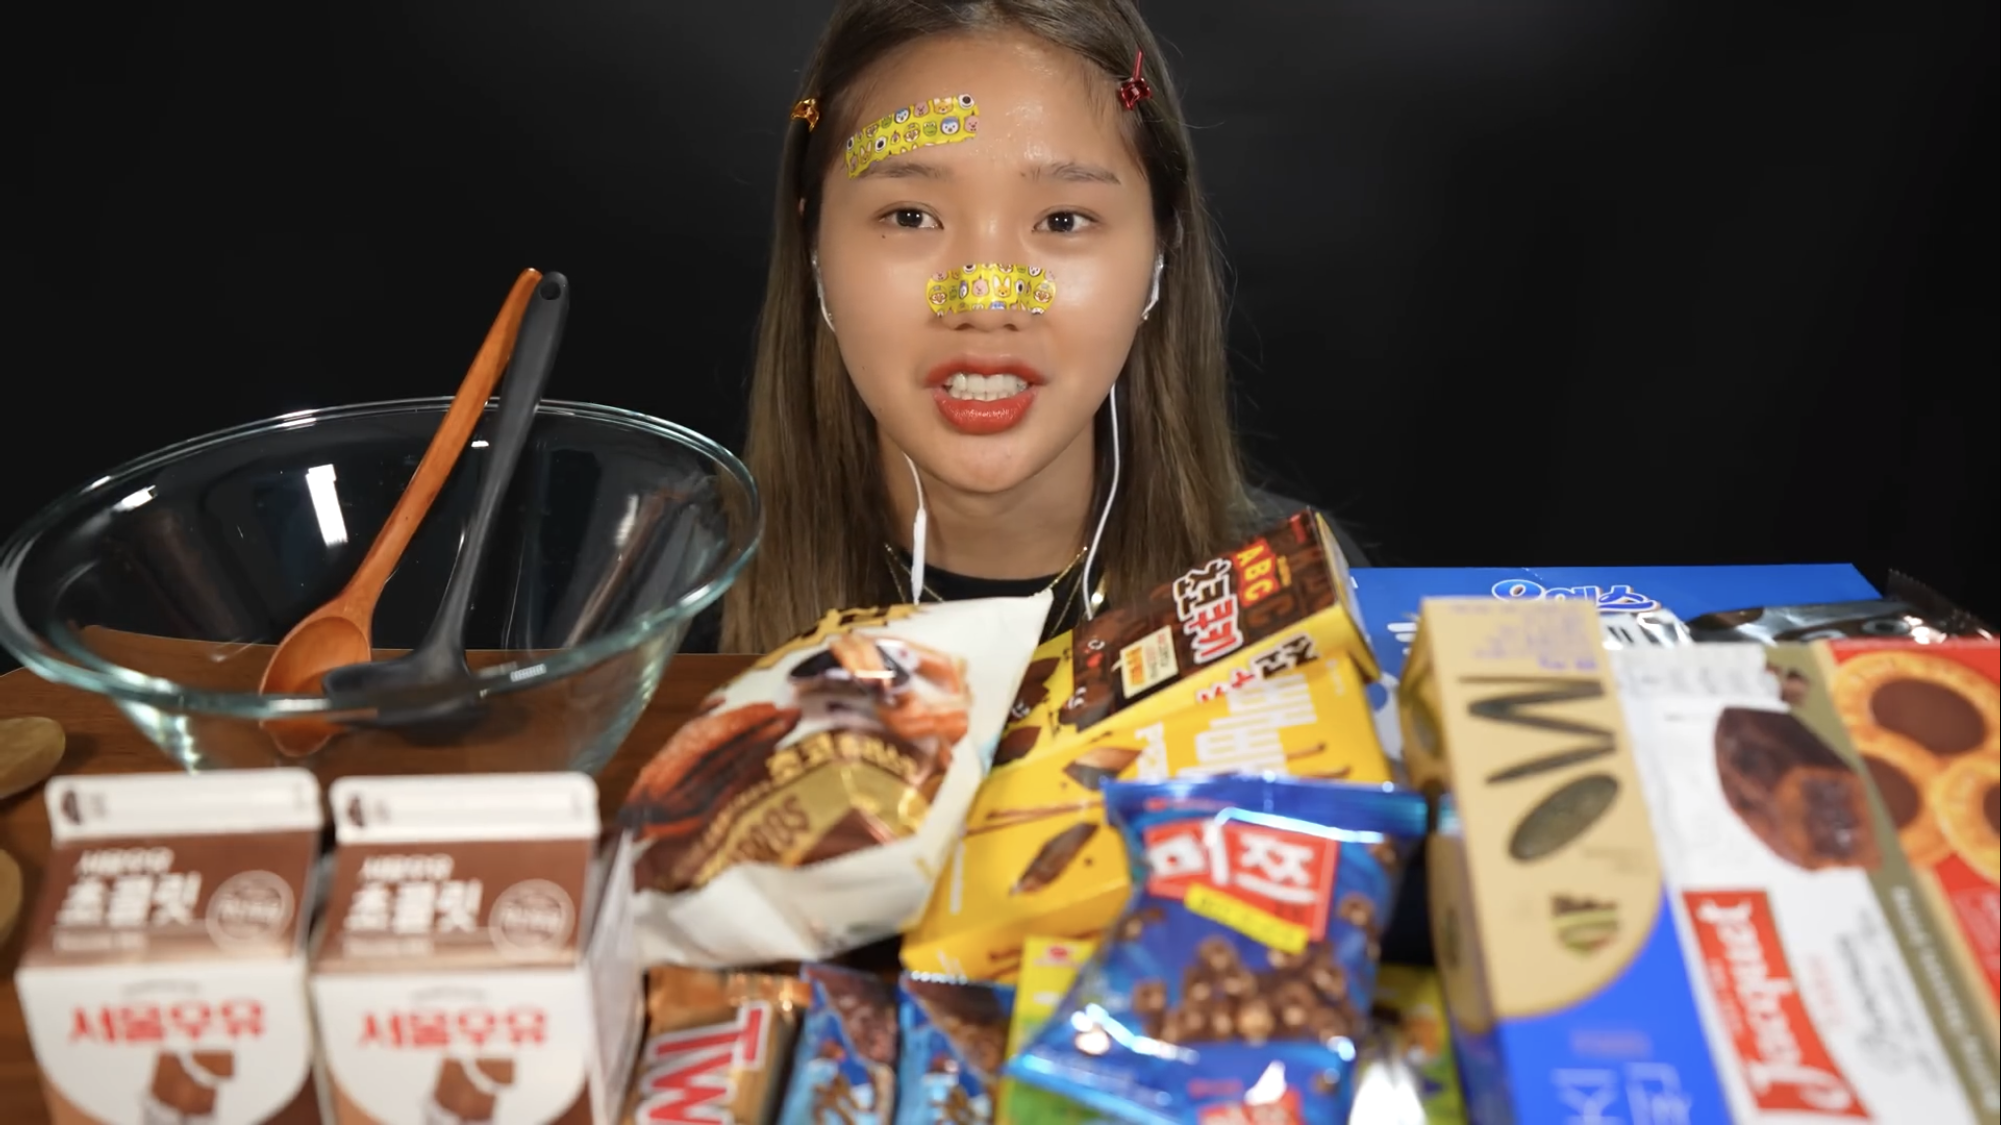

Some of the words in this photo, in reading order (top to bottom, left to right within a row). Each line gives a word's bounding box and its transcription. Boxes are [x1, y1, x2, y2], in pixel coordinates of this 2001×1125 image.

[1236, 543, 1276, 603] ABC
[1173, 557, 1244, 664] 초코쿠키
[68, 1000, 266, 1045] 서울우유
[358, 1005, 549, 1050] 서울우유
[1696, 897, 1852, 1111] Jacquet
